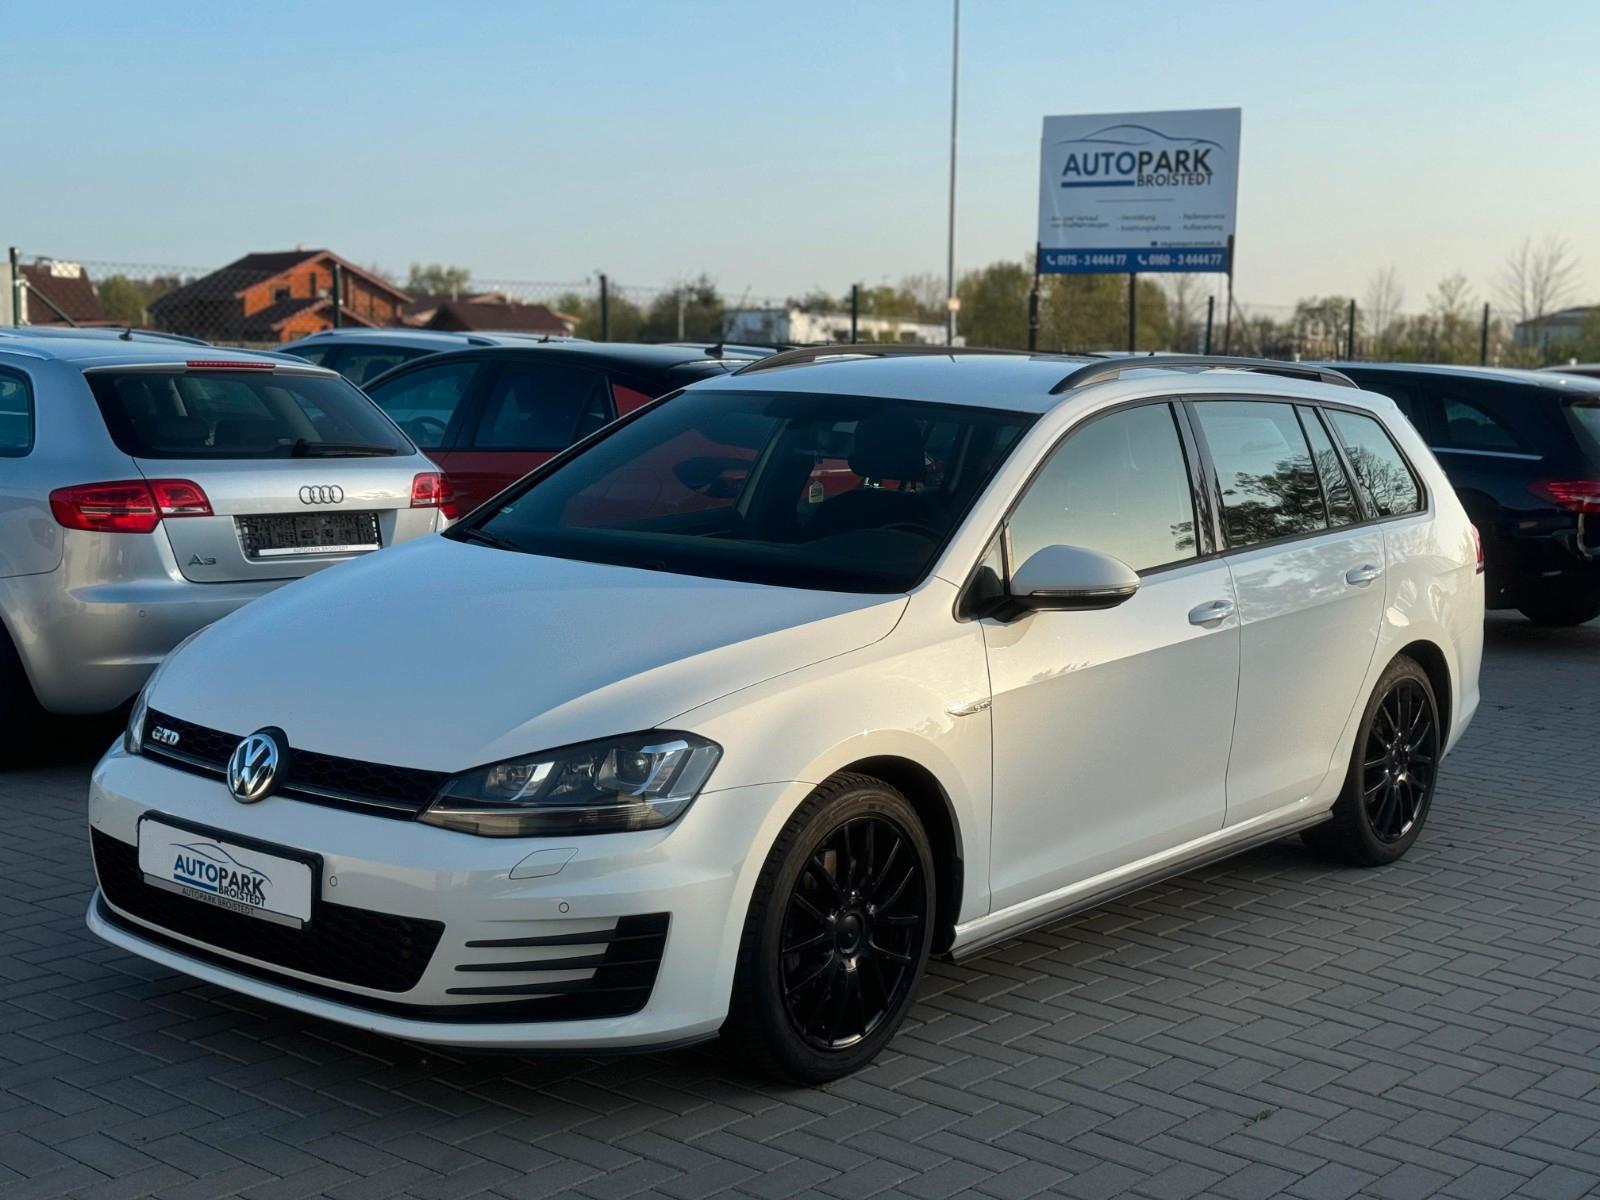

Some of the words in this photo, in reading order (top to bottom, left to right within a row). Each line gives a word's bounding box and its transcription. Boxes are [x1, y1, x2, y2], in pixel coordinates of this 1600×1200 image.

[1062, 149, 1213, 177] AUTOPARK
[1137, 173, 1213, 187] BROISTEDT
[188, 553, 217, 566] A3
[152, 726, 180, 746] GTD
[173, 854, 267, 899] AUTOPARK
[182, 887, 217, 905] AUTOPARK
[217, 898, 254, 915] BROISTEDT
[218, 884, 267, 908] BROISTEDT
